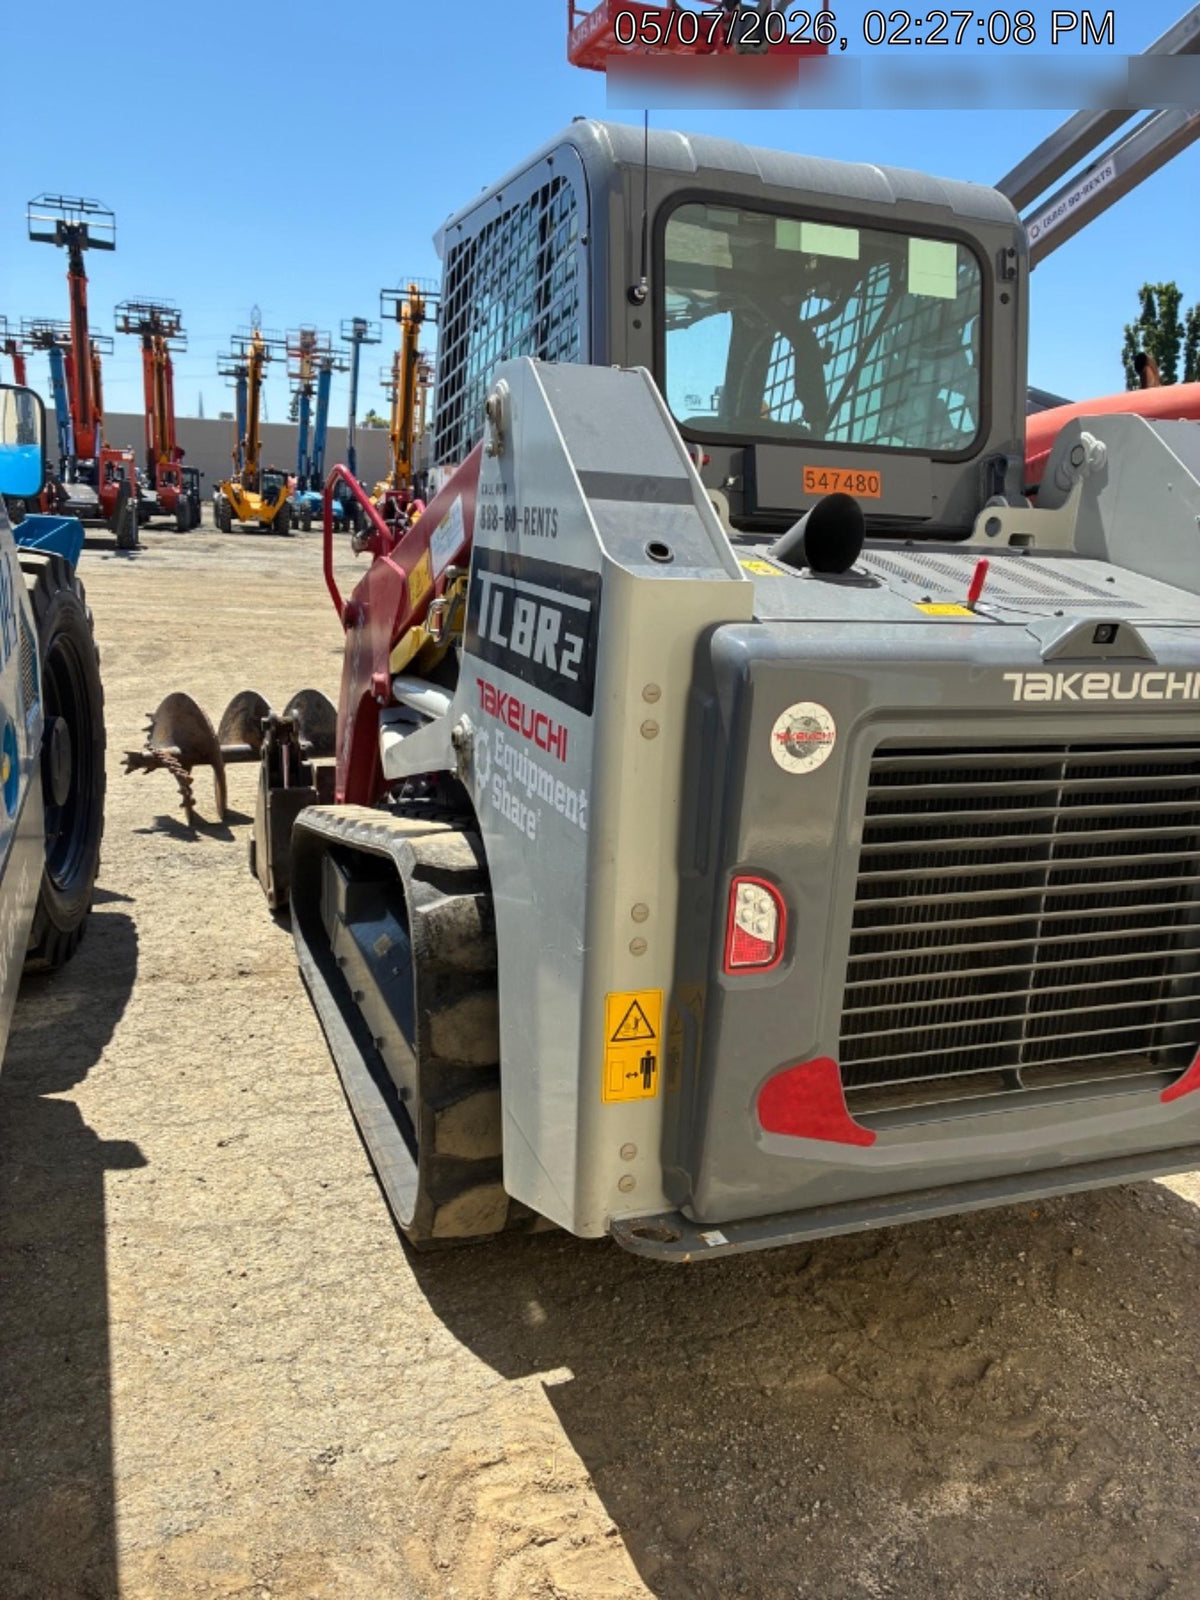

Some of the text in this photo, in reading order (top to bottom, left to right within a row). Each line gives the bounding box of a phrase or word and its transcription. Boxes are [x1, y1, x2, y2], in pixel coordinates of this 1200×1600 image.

[805, 470, 879, 493] 547480
[491, 772, 537, 841] Share
[494, 728, 589, 831] Equipment
